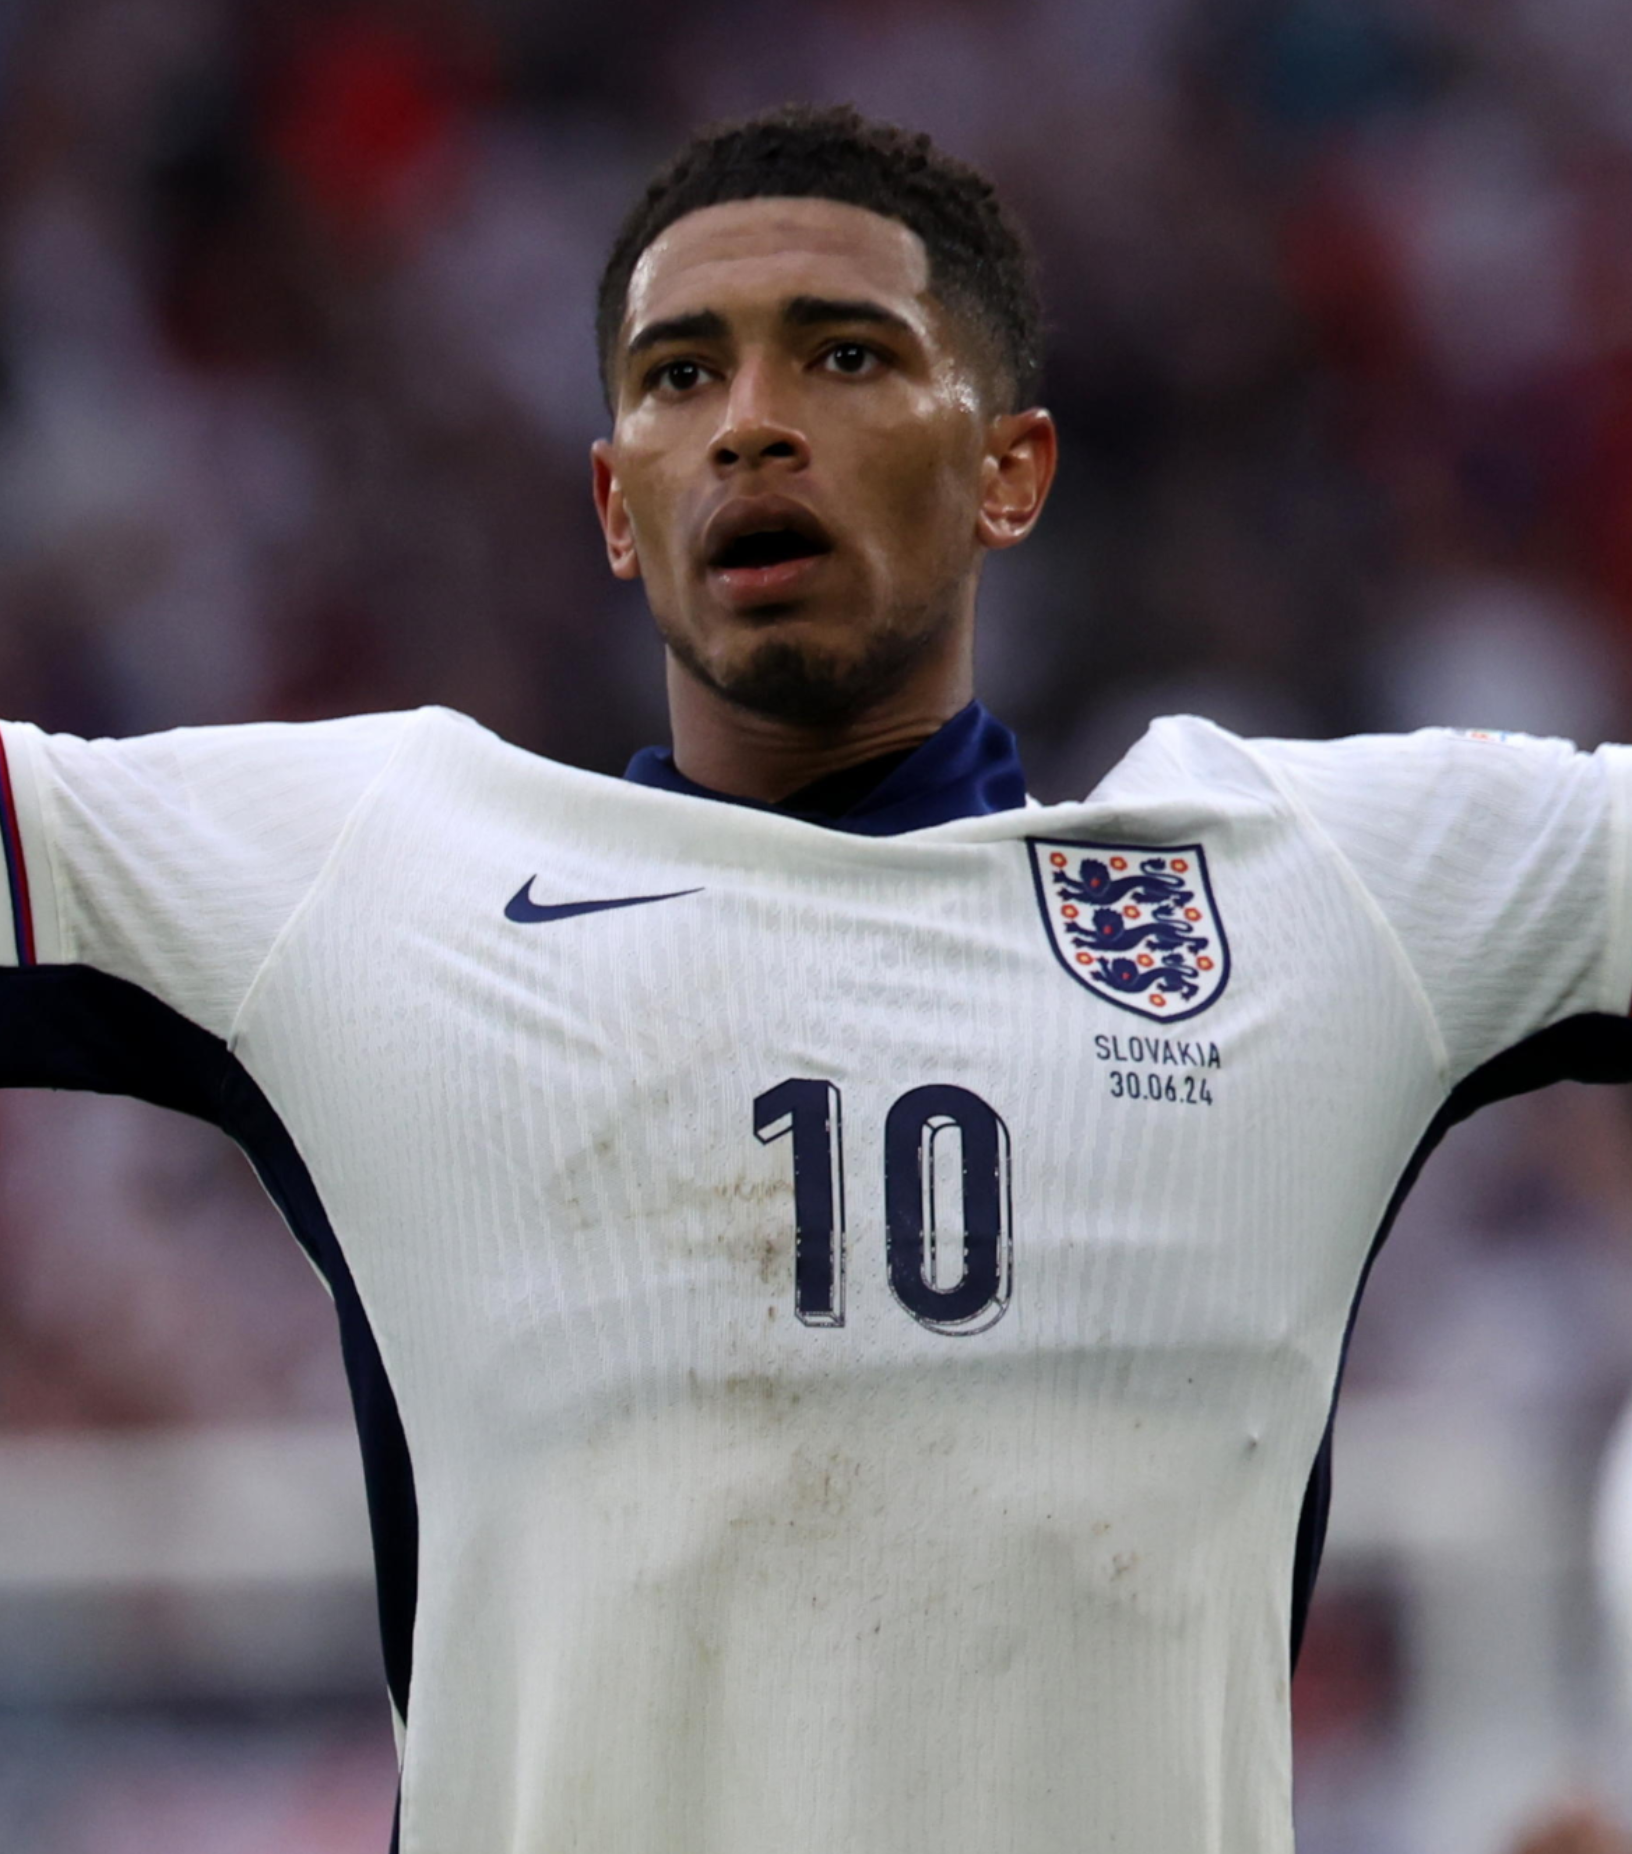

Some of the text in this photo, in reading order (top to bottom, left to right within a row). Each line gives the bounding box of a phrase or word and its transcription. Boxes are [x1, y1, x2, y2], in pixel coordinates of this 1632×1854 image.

[1094, 1034, 1221, 1069] SLOVAKIA
[1109, 1070, 1213, 1106] 30.06.24
[753, 1077, 1013, 1337] 10
